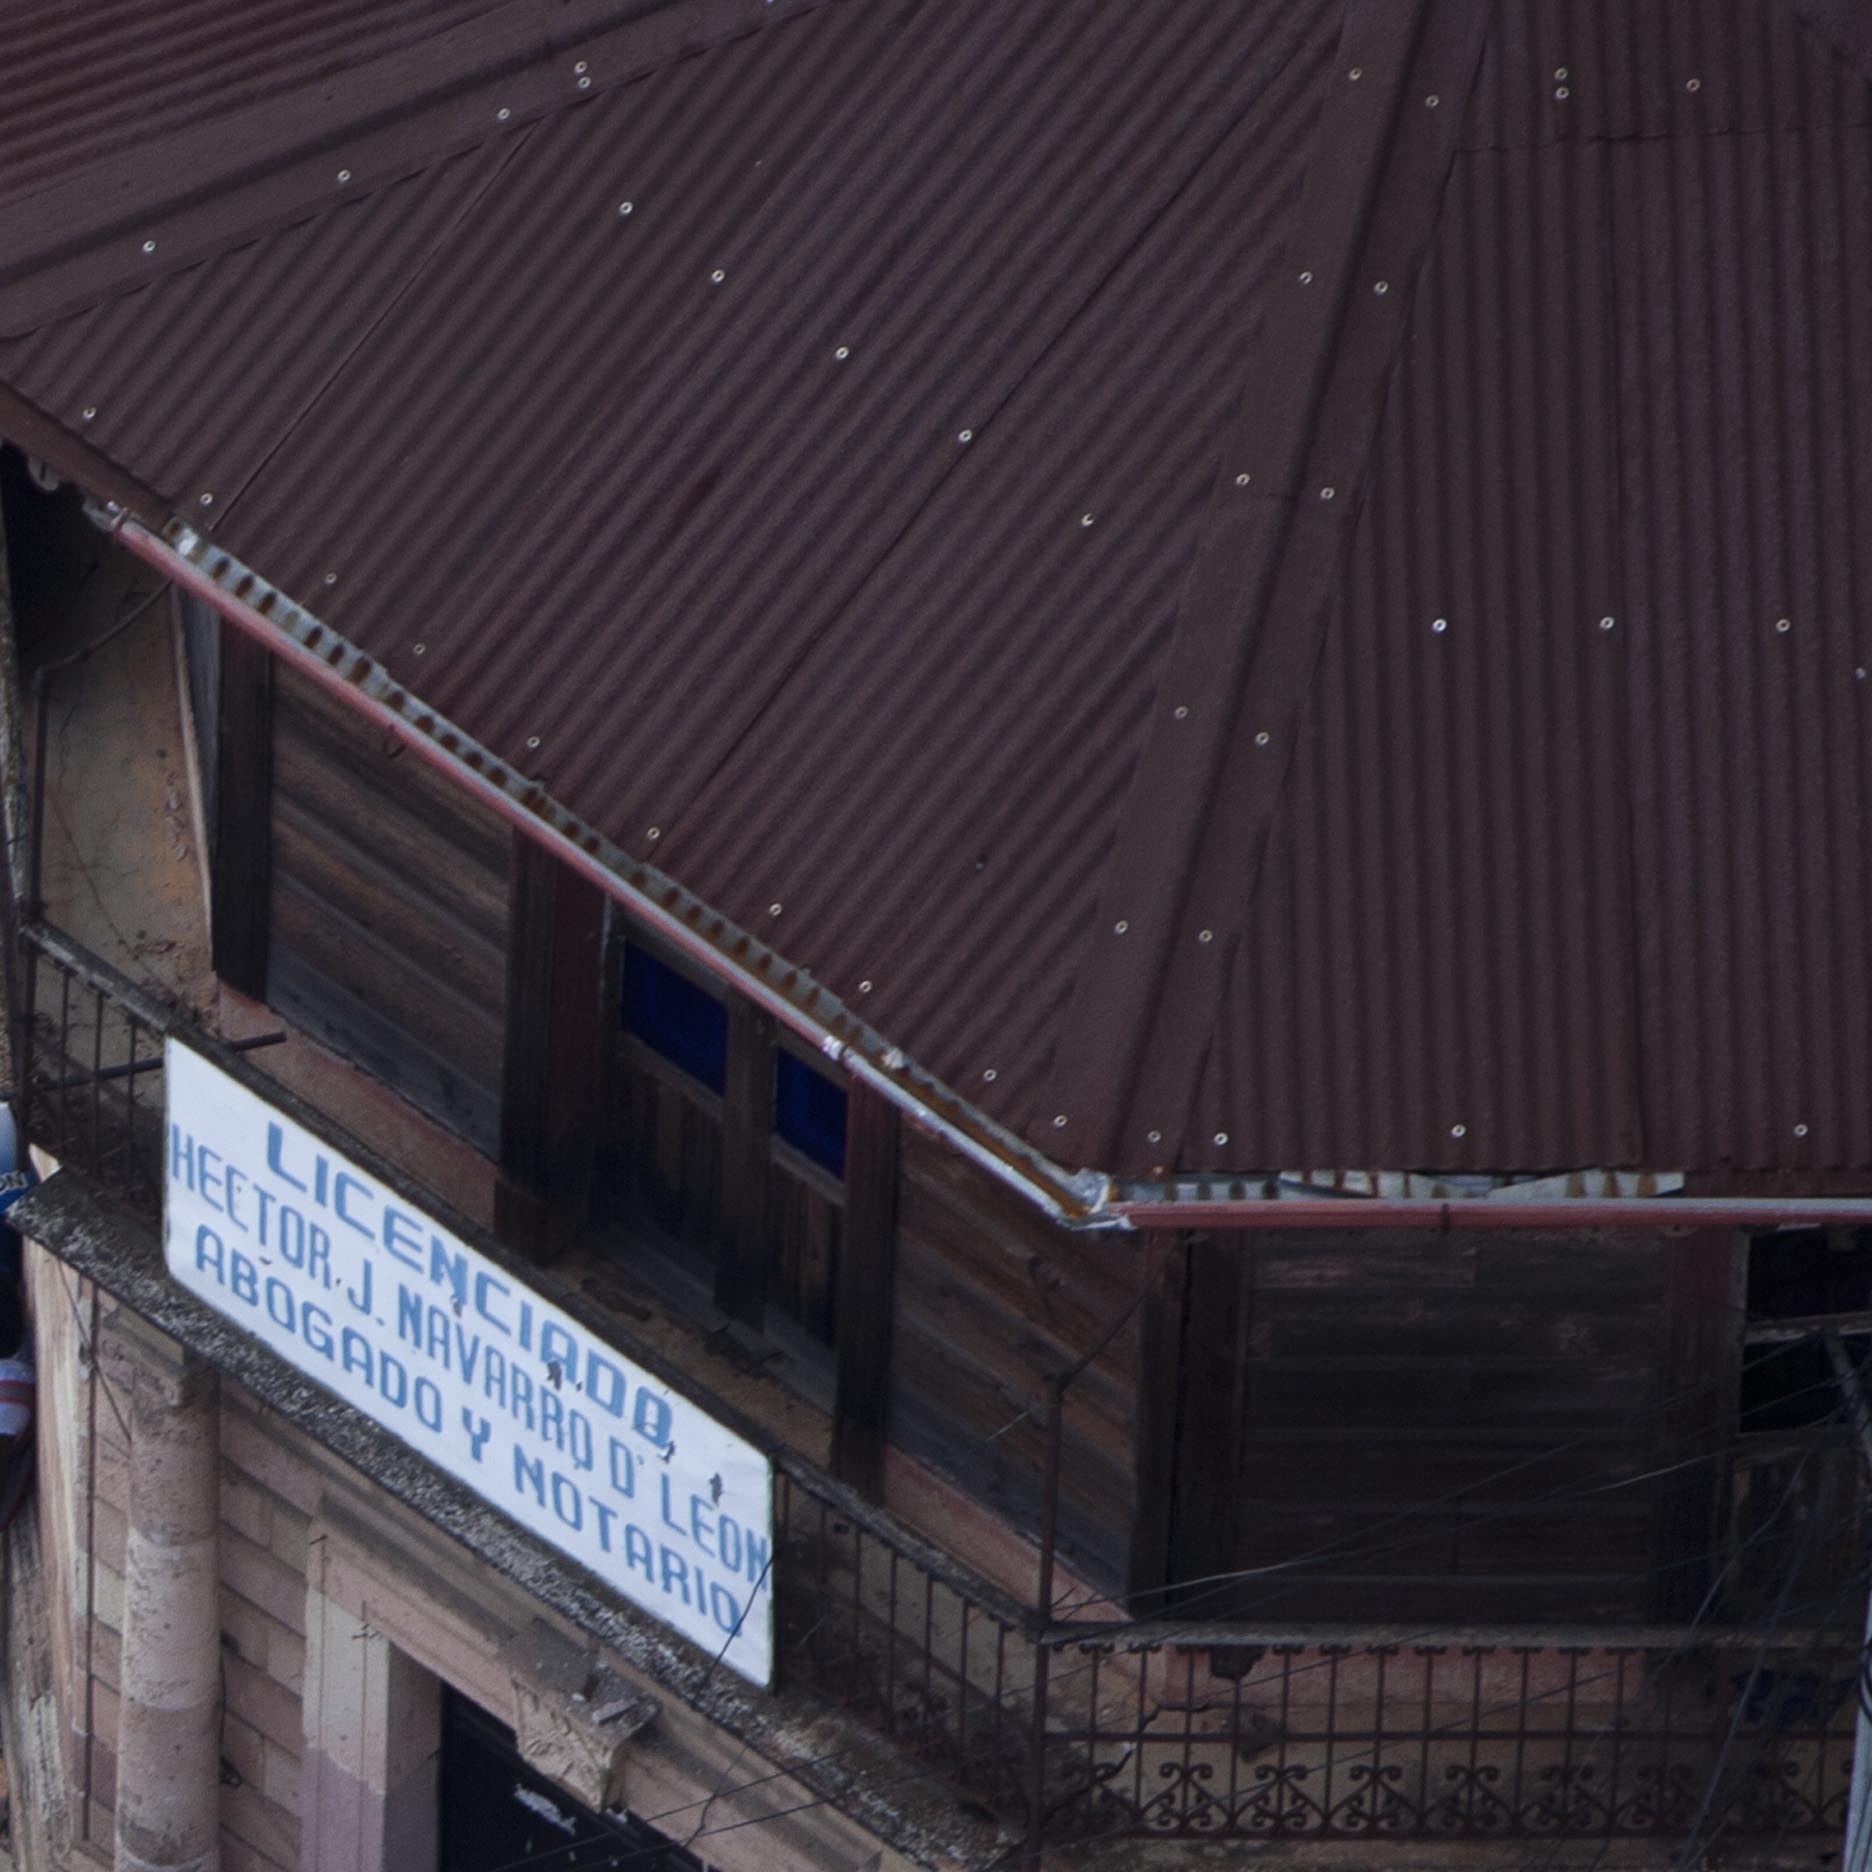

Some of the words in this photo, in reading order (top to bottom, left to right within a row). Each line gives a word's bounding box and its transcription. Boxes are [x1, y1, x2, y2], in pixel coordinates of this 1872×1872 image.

[170, 1123, 333, 1291] HECTOR
[346, 1260, 386, 1327] J.
[397, 1282, 594, 1472] NAVARRO
[660, 1474, 769, 1592] LEON
[194, 1223, 445, 1435] ABOGADO
[459, 1405, 493, 1463] Y
[512, 1444, 743, 1640] NOTARIO
[266, 1120, 674, 1452] LICENCIADO
